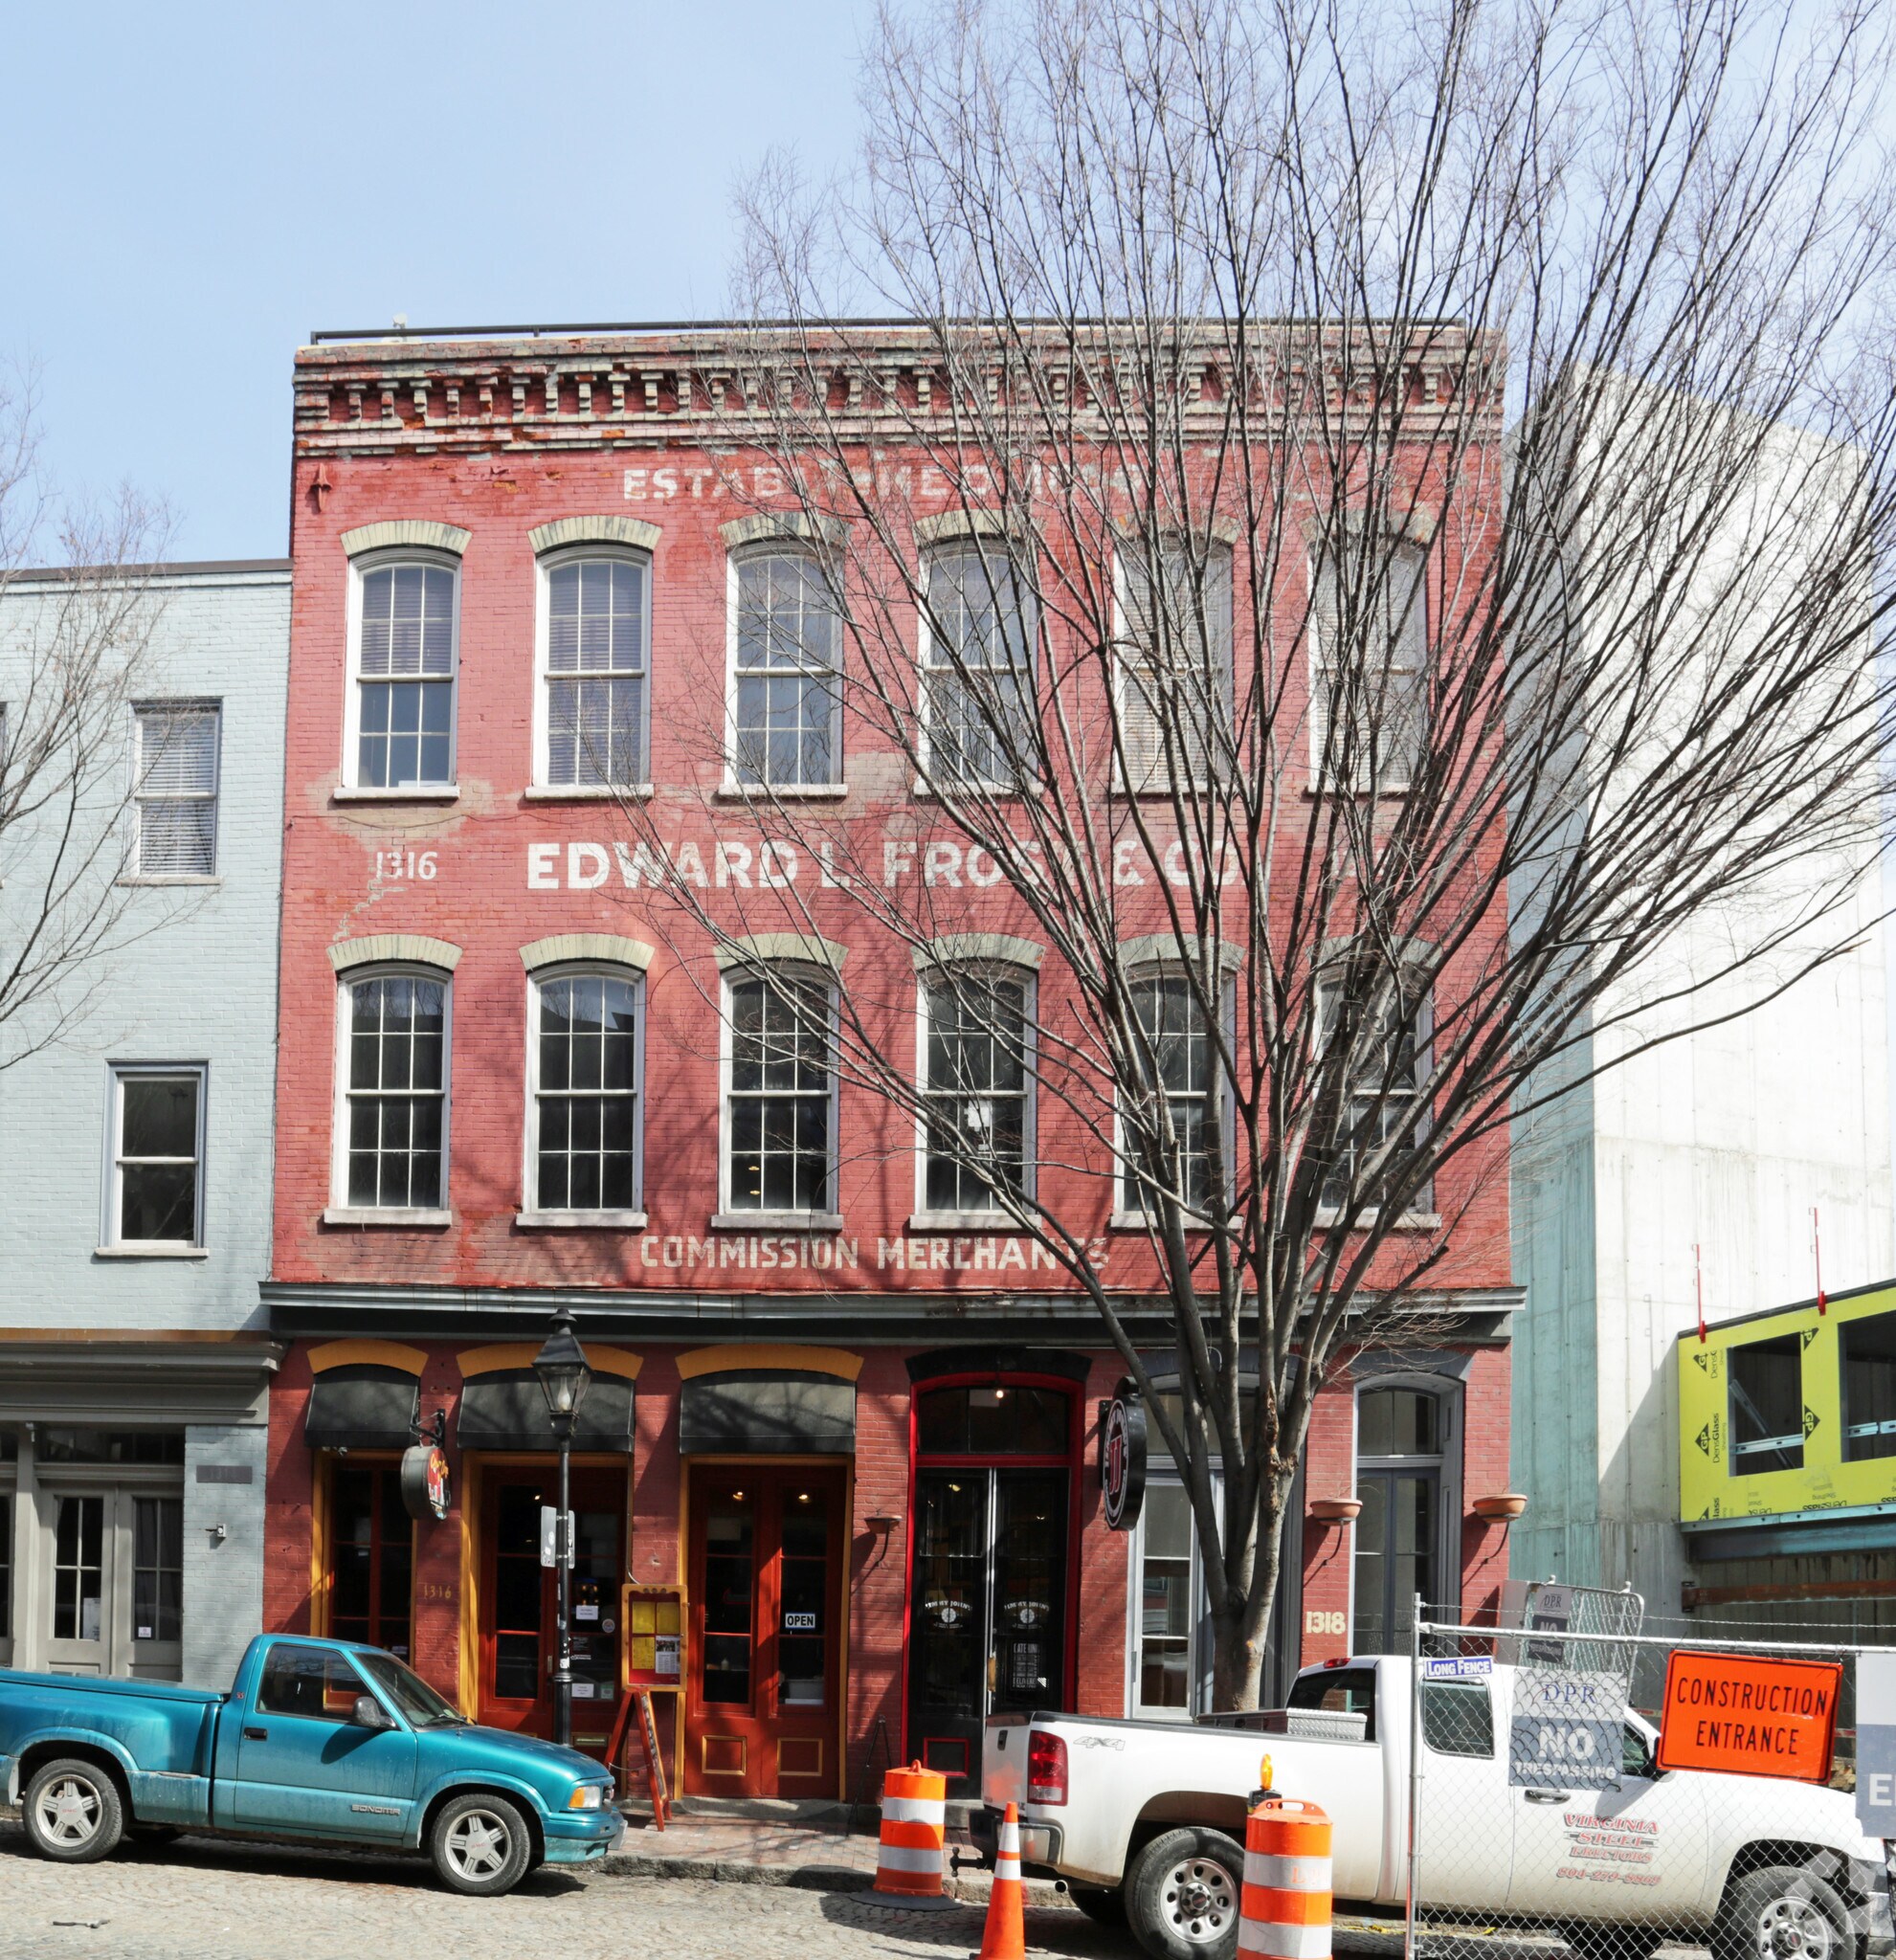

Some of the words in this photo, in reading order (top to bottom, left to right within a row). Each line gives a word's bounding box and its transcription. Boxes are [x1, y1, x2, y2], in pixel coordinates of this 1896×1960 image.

[624, 464, 992, 500] ESTABISHED
[375, 851, 437, 880] 1316
[527, 841, 798, 889] EDWARD
[1113, 839, 1145, 886] &
[640, 1236, 859, 1270] COMMISSION
[878, 1236, 1109, 1271] MERCHANTS
[424, 1584, 452, 1599] 1316
[1543, 1594, 1563, 1609] DPR
[787, 1615, 814, 1627] OPEN
[1305, 1611, 1347, 1635] 1318
[1427, 1661, 1456, 1677] LONG
[1457, 1659, 1490, 1675] FENCE
[1542, 1683, 1597, 1704] DPR
[1677, 1677, 1828, 1716] CONSTRUCTION
[1538, 1726, 1595, 1760] NO
[1696, 1720, 1799, 1755] ENTRANCE
[1514, 1761, 1617, 1780] TRESPASSING
[351, 1804, 401, 1815] SONOMA
[1564, 1813, 1659, 1834] VIRGINIA
